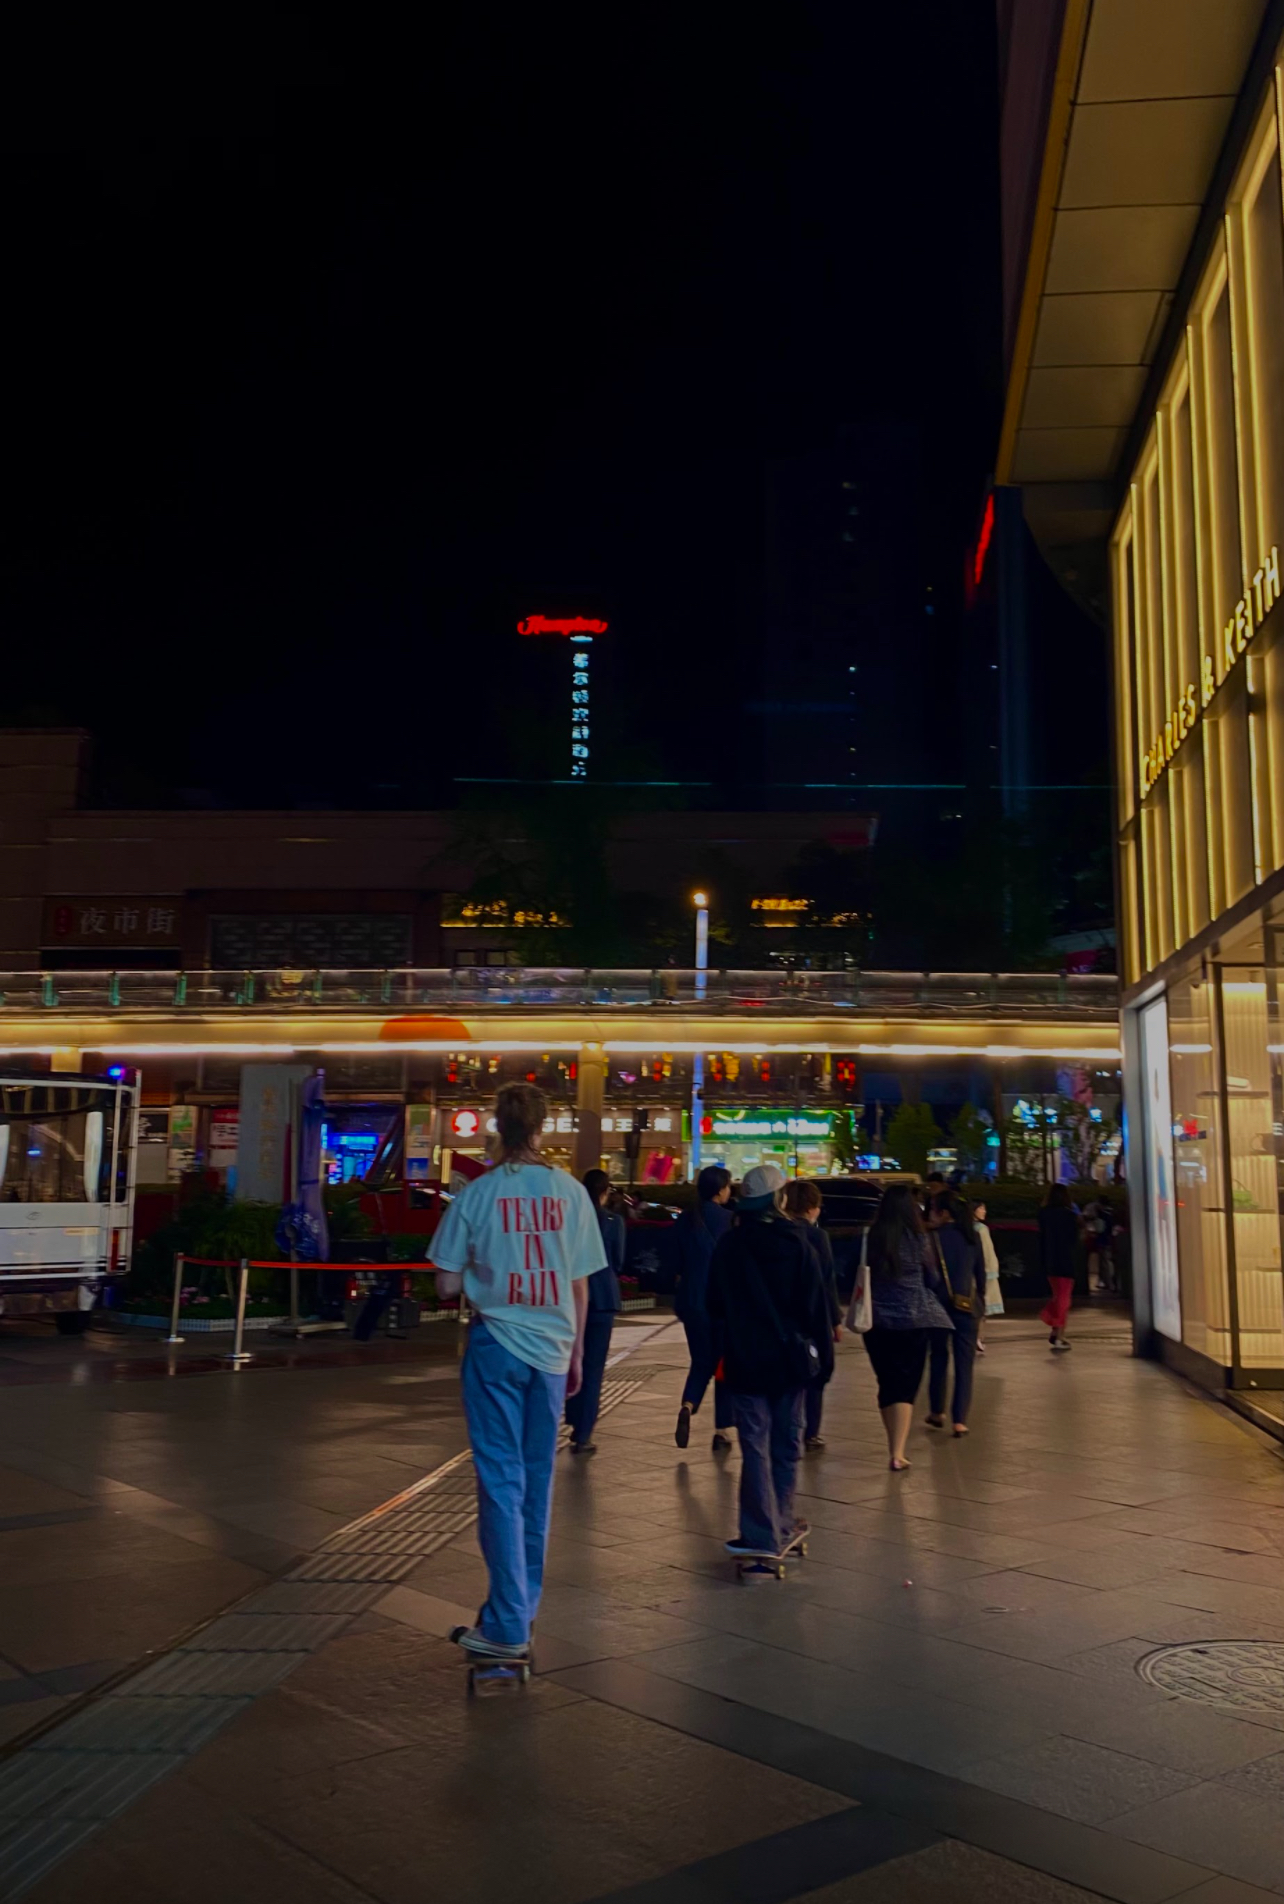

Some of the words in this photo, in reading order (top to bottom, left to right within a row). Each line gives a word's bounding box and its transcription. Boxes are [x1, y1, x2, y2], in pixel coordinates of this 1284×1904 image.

[1142, 683, 1196, 793] CHARLES
[1202, 656, 1215, 707] &
[1224, 546, 1280, 671] KEITH
[80, 908, 176, 935] 夜市街
[497, 1197, 567, 1234] TEARS
[524, 1233, 546, 1269] IN
[508, 1271, 560, 1306] RAIN
